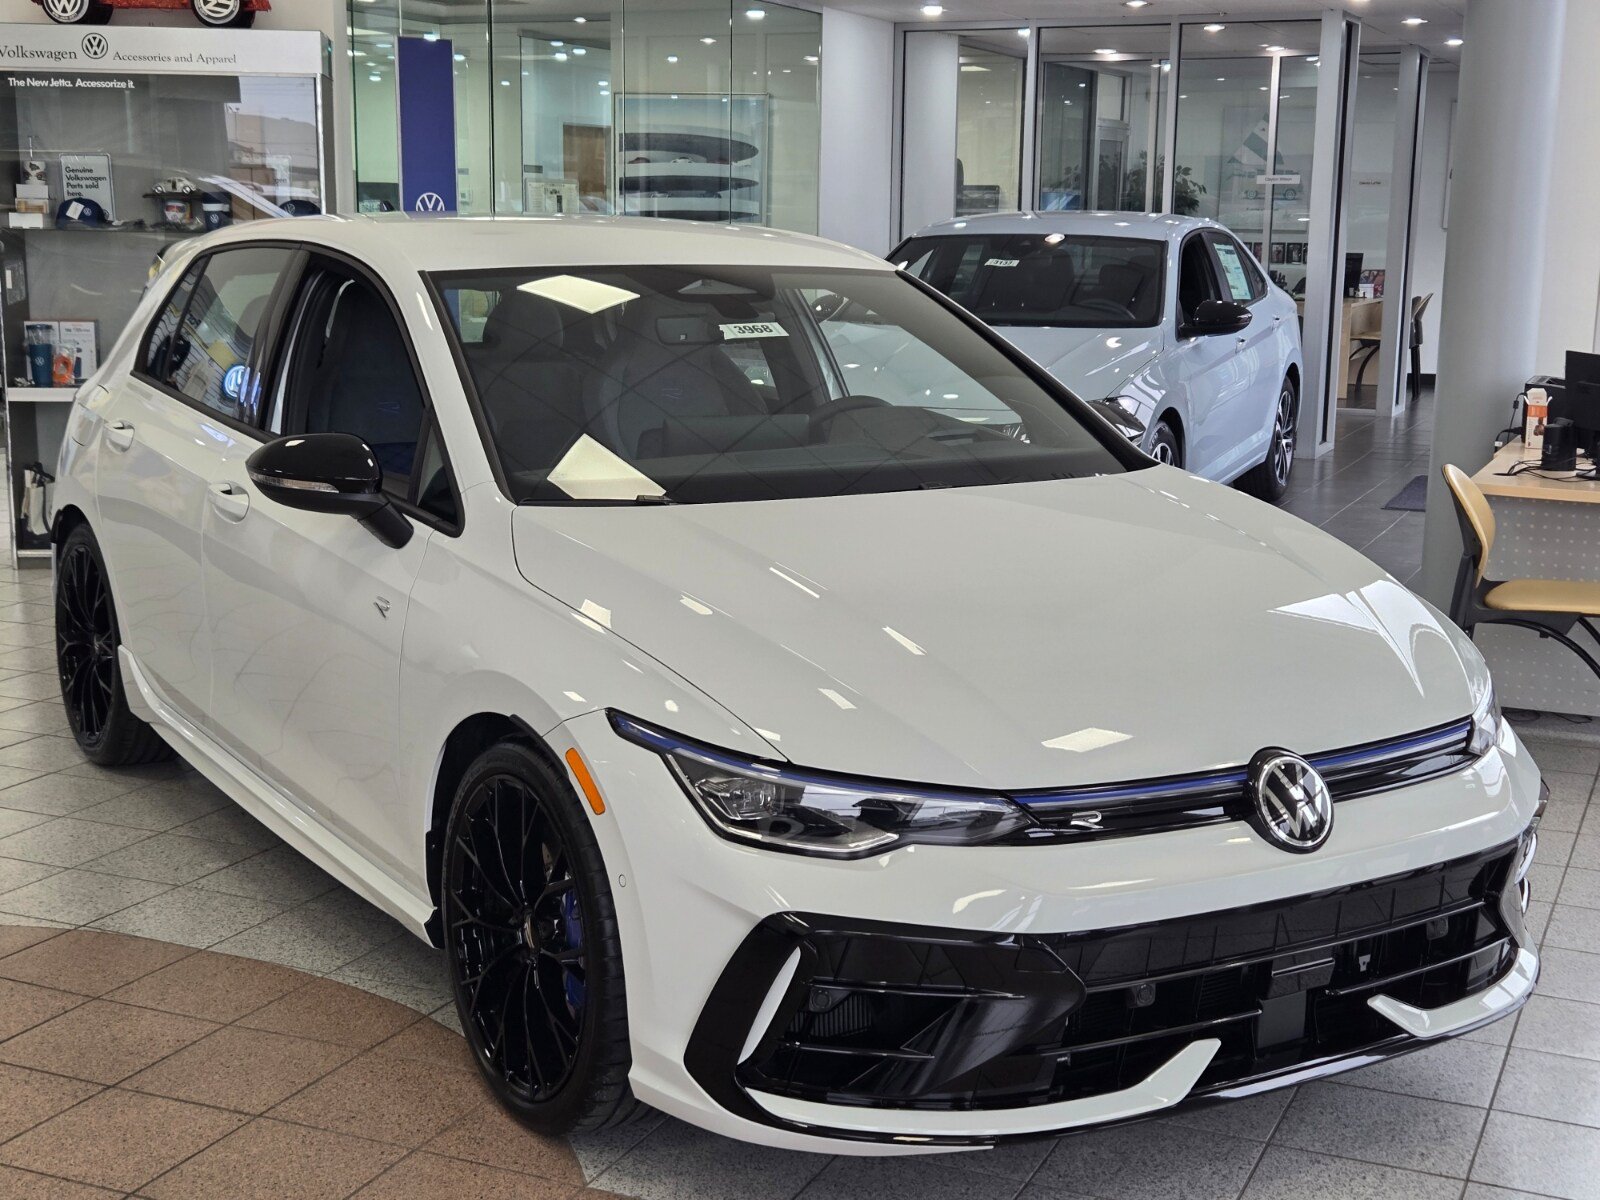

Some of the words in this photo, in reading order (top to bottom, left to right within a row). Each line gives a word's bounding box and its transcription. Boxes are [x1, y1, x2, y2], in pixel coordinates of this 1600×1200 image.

[113, 51, 172, 62] Accessories
[174, 53, 193, 63] and
[196, 53, 237, 65] Apparel
[8, 77, 25, 87] The
[26, 77, 48, 87] New
[75, 78, 127, 89] Accessorize
[65, 166, 94, 174] Genuine
[65, 174, 107, 183] Volkswagen
[733, 324, 774, 335] 3968
